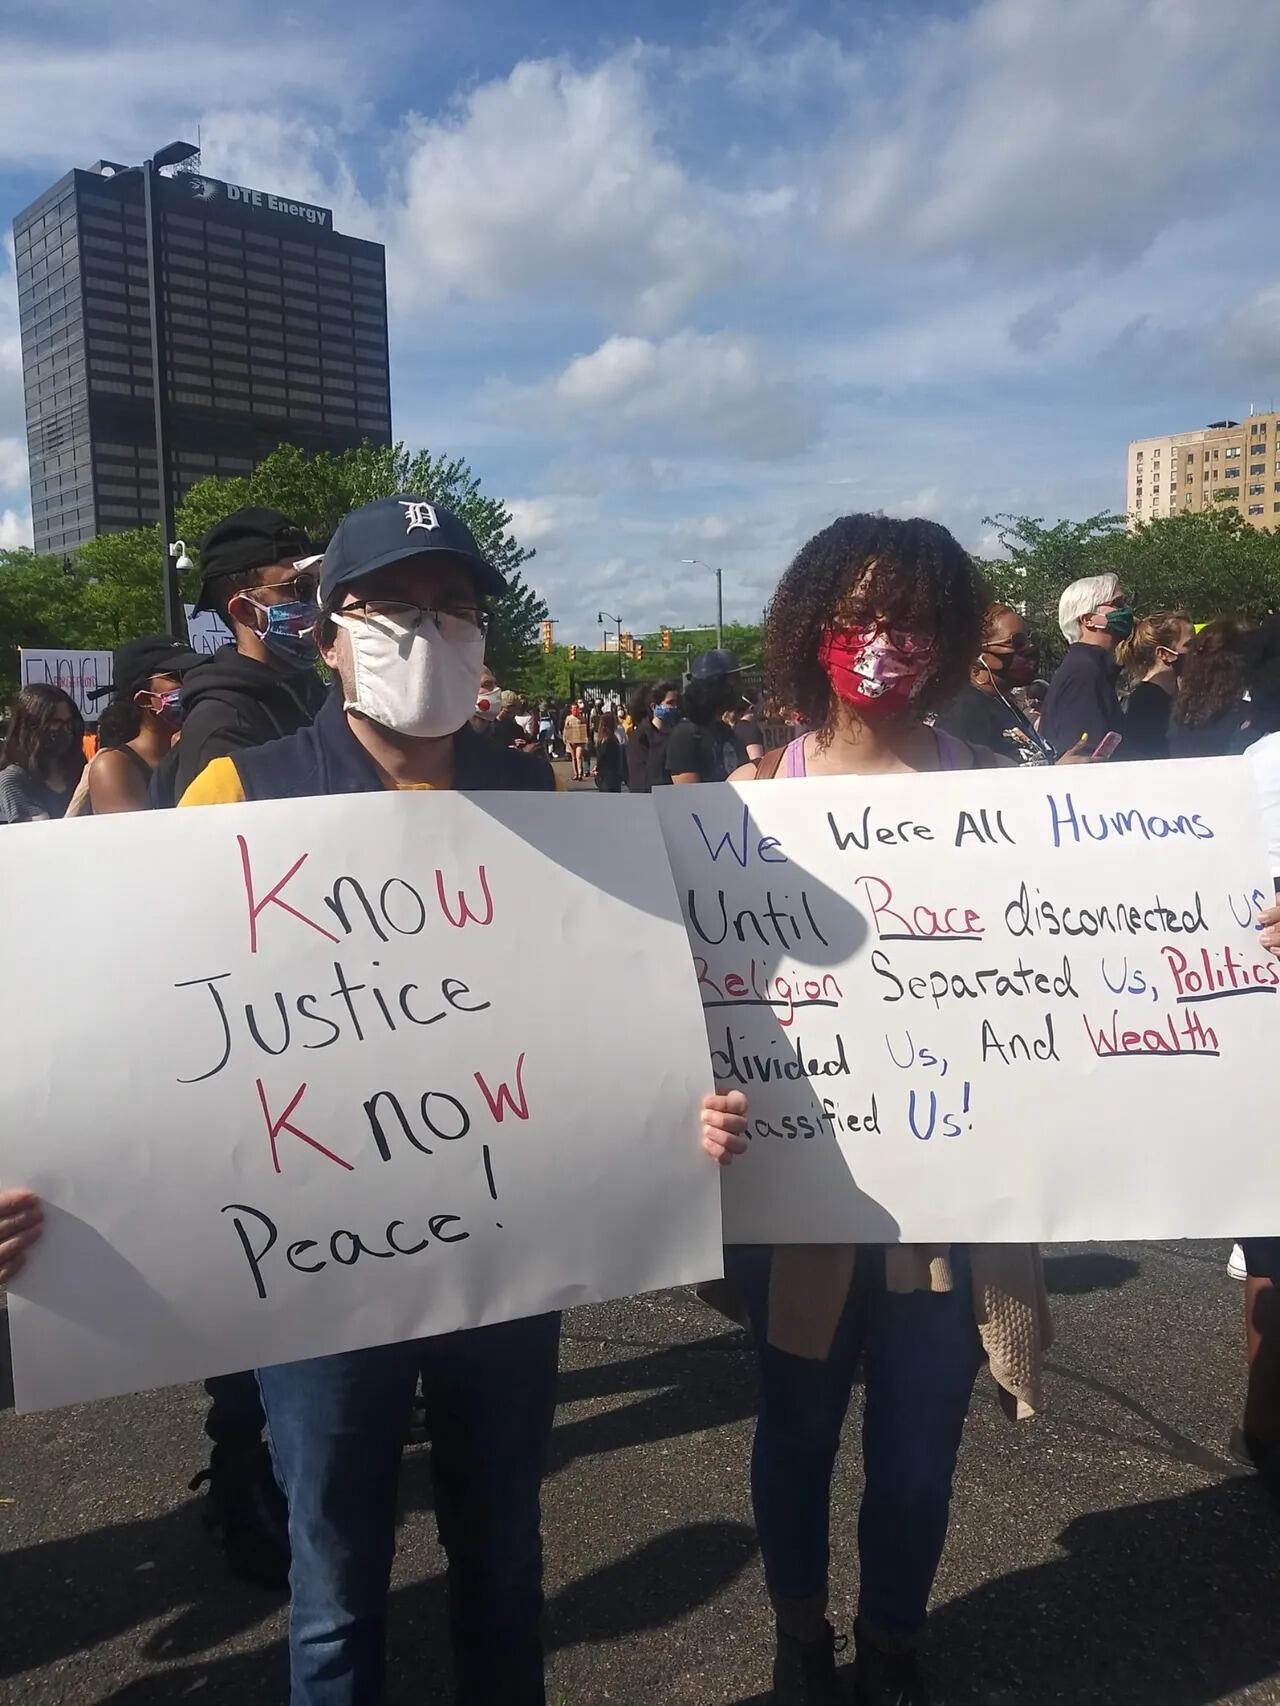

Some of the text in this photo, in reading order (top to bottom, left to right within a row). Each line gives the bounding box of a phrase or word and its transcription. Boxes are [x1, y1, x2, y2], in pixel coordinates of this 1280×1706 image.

[226, 183, 327, 226] DTE Energy
[398, 500, 440, 535] D
[691, 792, 1215, 867] We Were All Humans
[688, 888, 829, 950] Until
[854, 875, 986, 937] Race
[1004, 879, 1209, 937] disconnected
[870, 949, 1079, 1010] Separated
[1100, 956, 1159, 1002] Us,
[1160, 945, 1280, 998] Politics
[174, 960, 491, 1084] Justice
[710, 1007, 1220, 1084] divided Us, And Wealth
[744, 1081, 973, 1141] assified Us!
[221, 1143, 505, 1300] Peace!
